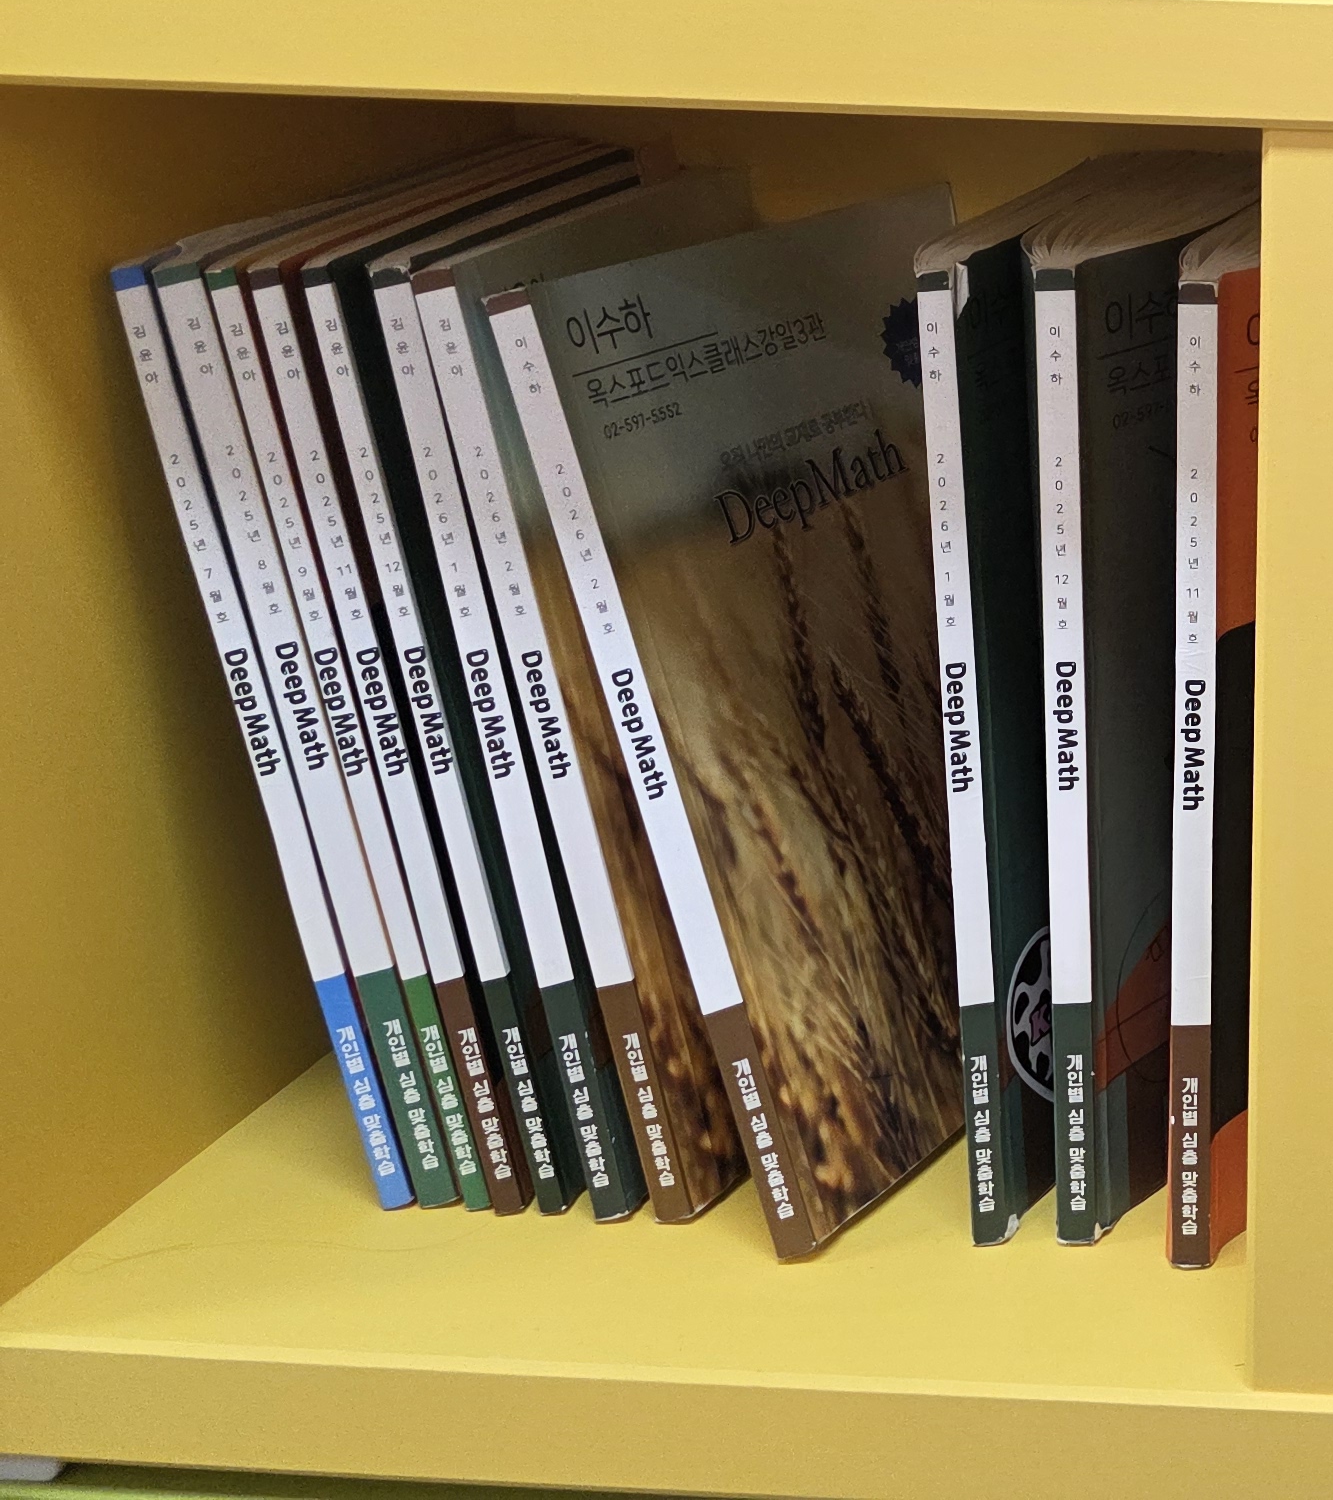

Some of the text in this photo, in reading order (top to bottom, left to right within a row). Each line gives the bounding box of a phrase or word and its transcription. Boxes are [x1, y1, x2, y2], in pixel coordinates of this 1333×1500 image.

[514, 336, 543, 395] 이수하
[566, 293, 654, 354] 이수하
[1189, 335, 1202, 398] 이수하
[603, 402, 683, 439] 02-597-5552
[714, 429, 911, 547] DeepMath
[335, 1024, 397, 1178] 개인별 심층 맞춤학습
[731, 1057, 795, 1219] 개인별 심층 맞춤학습
[1180, 1077, 1200, 1237] 개인별 심층 맞춤학습
